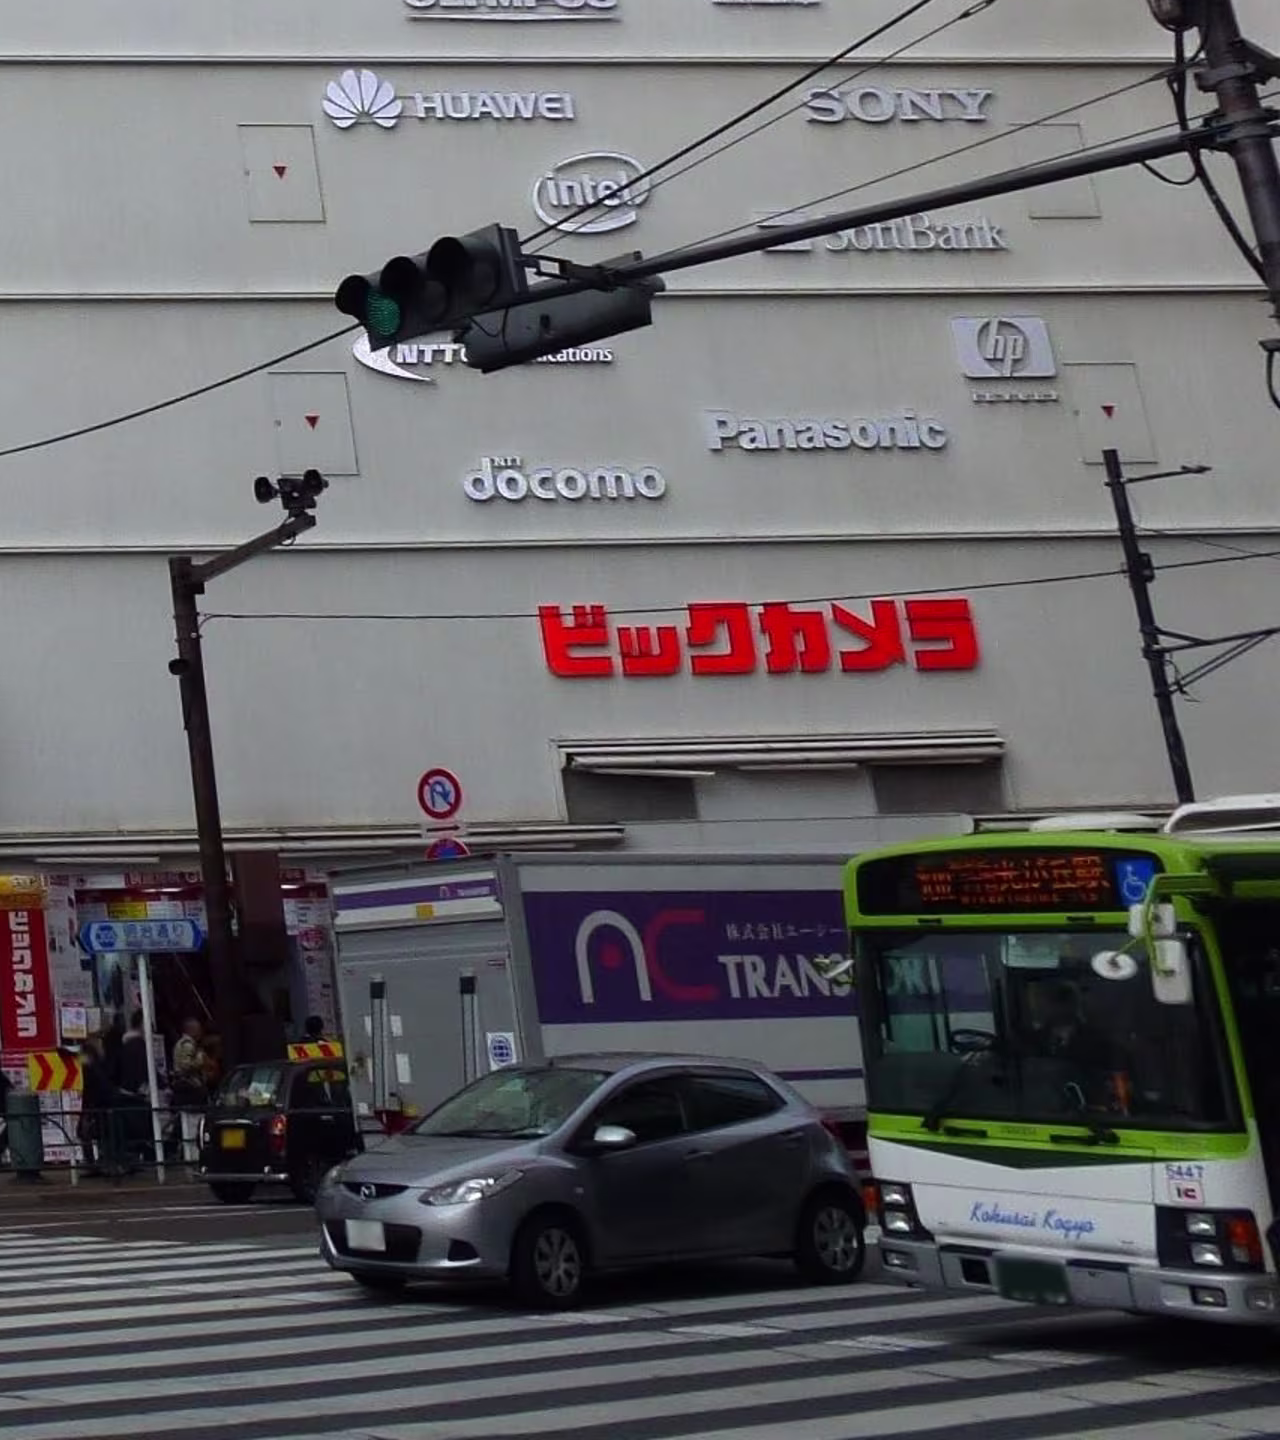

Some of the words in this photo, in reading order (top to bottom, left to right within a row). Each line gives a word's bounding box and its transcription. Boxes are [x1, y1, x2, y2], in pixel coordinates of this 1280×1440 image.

[414, 91, 575, 121] HUAWEI
[805, 86, 993, 123] SONY
[546, 172, 631, 208] intel
[395, 343, 457, 364] NTT
[984, 319, 1024, 377] hp
[708, 408, 947, 451] Panasonic
[463, 456, 667, 502] docomo
[538, 597, 979, 678] ビックカメラ
